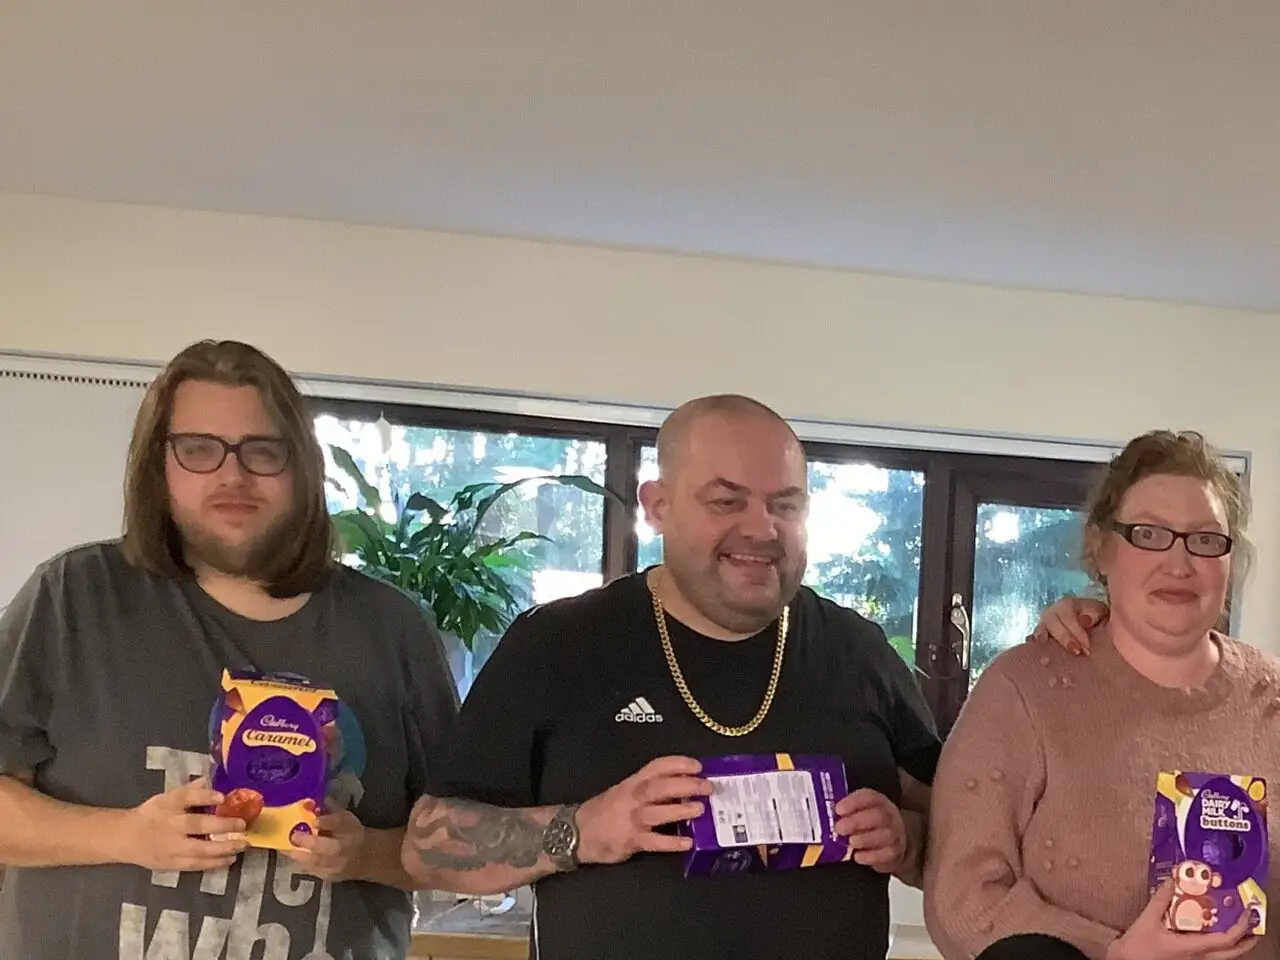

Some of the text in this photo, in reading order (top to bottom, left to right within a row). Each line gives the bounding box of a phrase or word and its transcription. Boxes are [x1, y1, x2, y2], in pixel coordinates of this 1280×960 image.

[260, 714, 300, 732] Cadbury
[615, 712, 664, 723] adidas
[246, 730, 313, 748] Caramel
[1201, 799, 1231, 809] DAIRY
[1201, 806, 1227, 817] MILK
[1202, 817, 1249, 829] buttons
